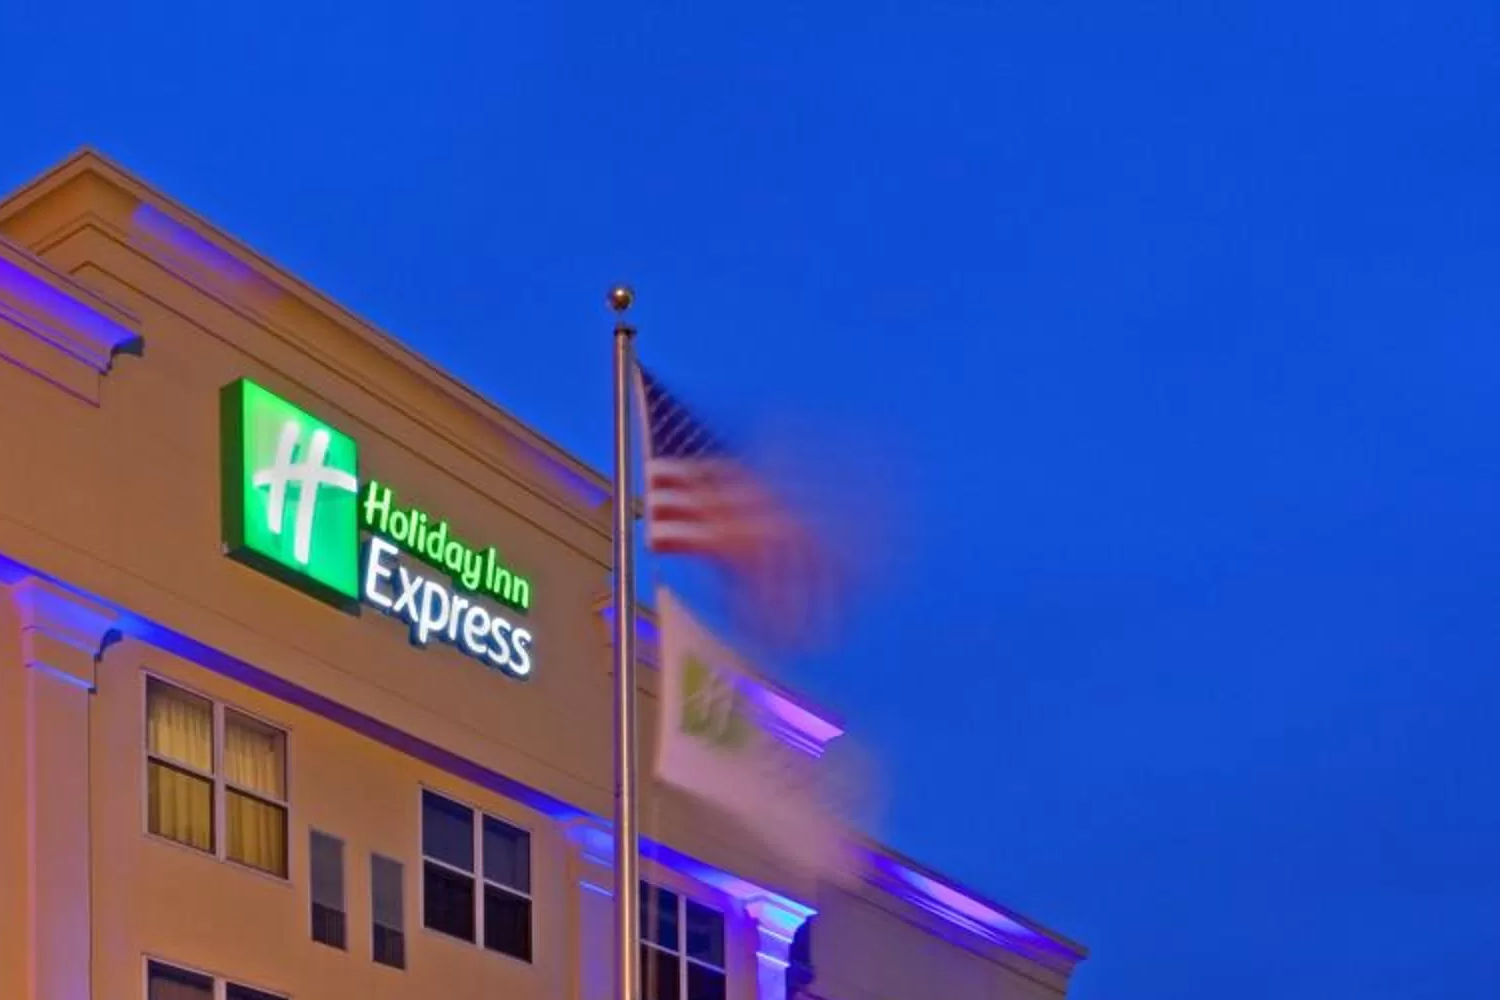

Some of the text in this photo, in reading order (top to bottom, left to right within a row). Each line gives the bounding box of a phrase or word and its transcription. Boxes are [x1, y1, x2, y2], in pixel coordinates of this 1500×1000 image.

[364, 480, 530, 608] Holiday Inn
[365, 536, 532, 676] Express
